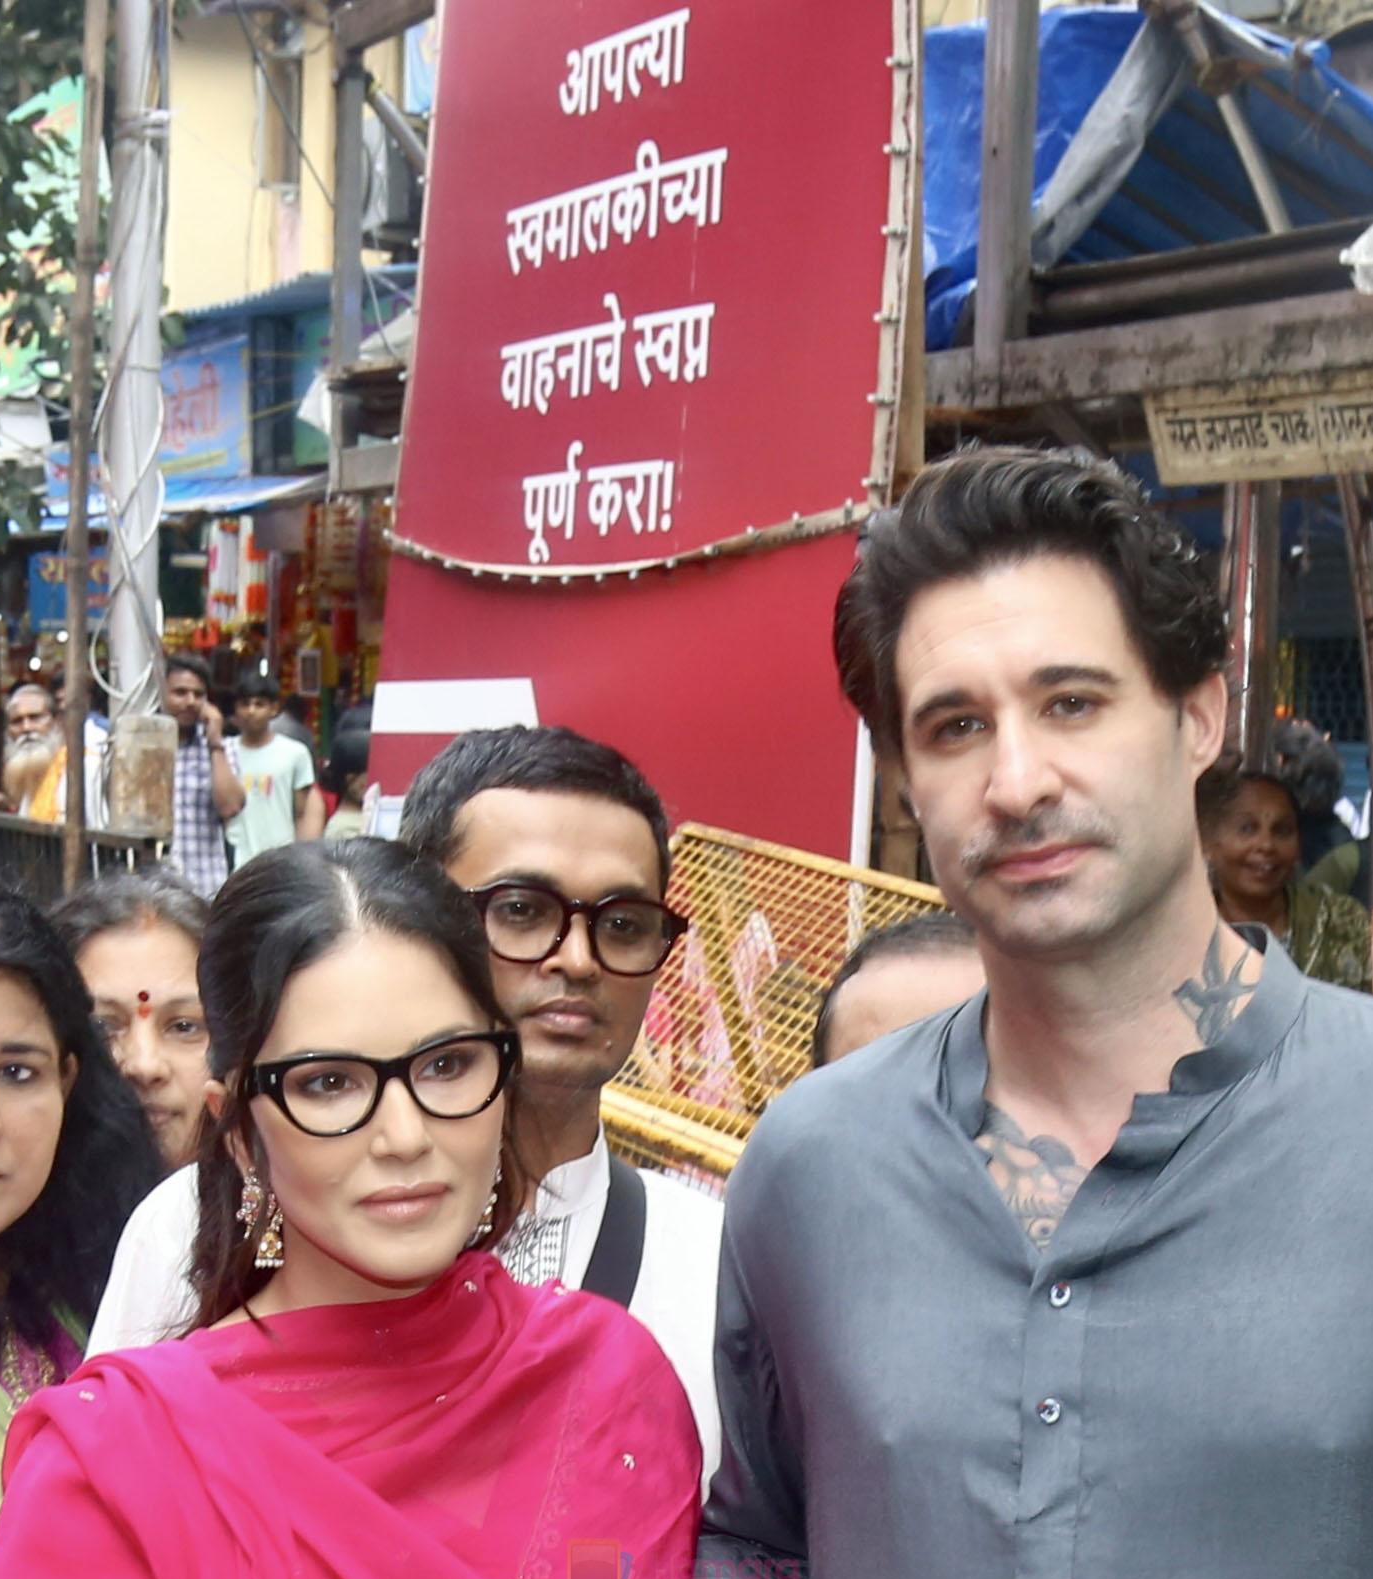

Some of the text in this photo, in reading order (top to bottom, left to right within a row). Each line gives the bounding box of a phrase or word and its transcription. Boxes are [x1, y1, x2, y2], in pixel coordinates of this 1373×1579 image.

[559, 8, 690, 116] आपल्या
[505, 139, 728, 275] स्वमालकीच्या
[500, 293, 715, 414] वाहनाचे स्वप्न
[521, 440, 676, 563] पूर्ण करा!
